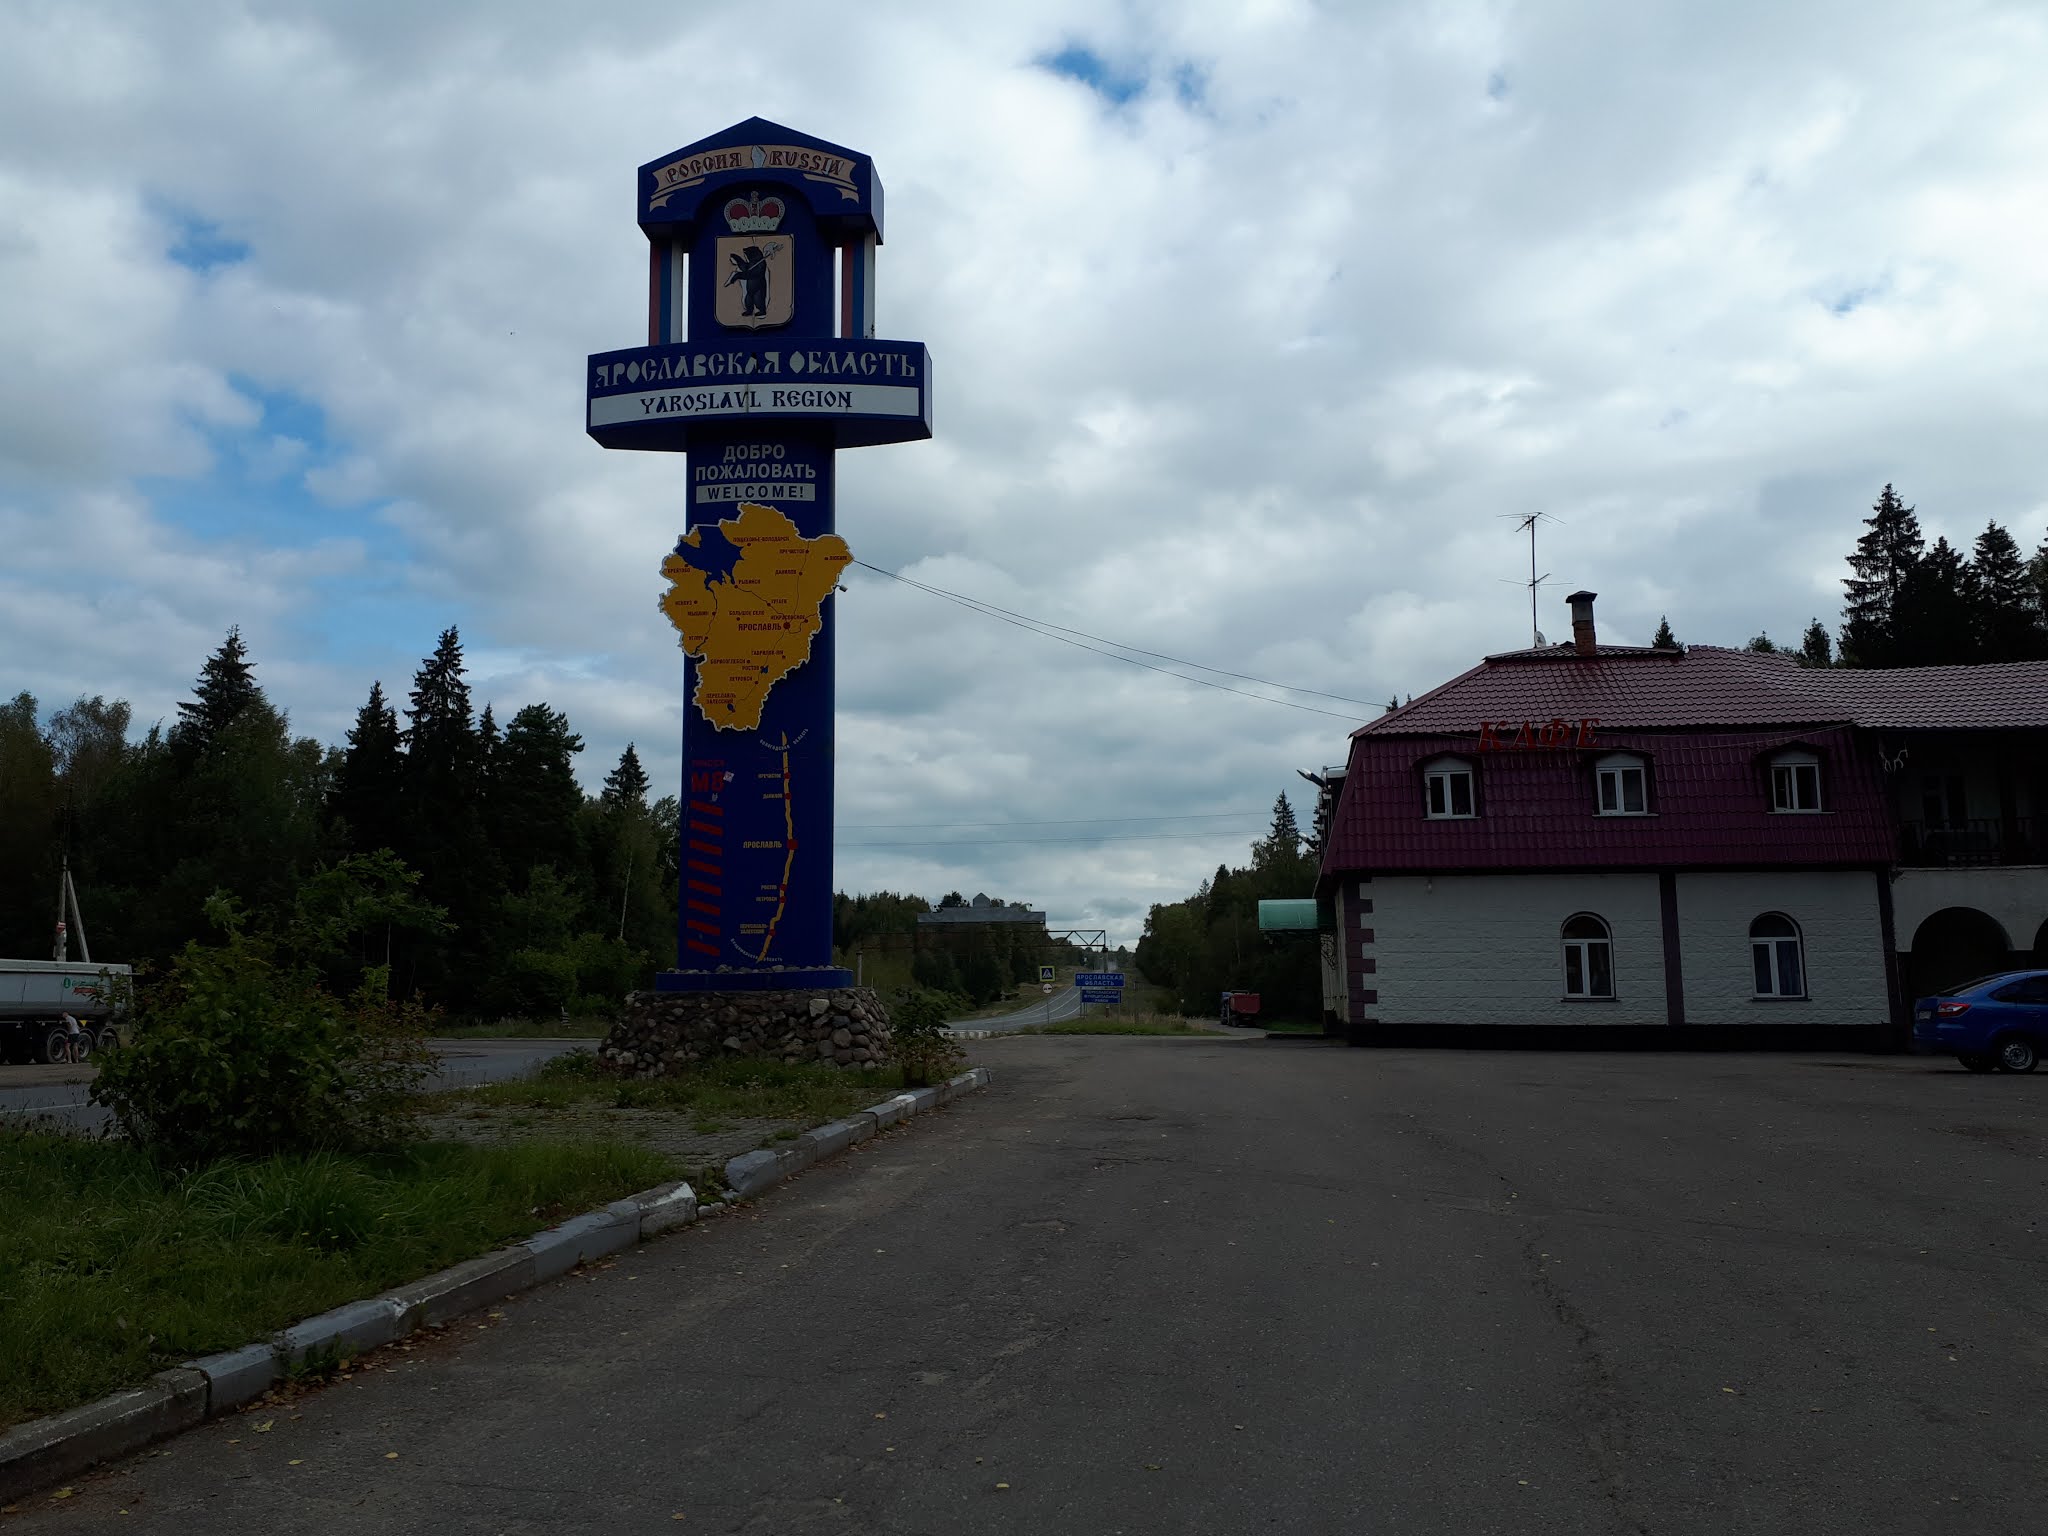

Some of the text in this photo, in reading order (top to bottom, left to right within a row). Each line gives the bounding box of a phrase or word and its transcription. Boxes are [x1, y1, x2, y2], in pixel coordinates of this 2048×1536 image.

[667, 153, 742, 183] РОССИЯ
[595, 350, 916, 389] ЯРОСЛАВСКАЯ ОБЛАСТЬ
[640, 390, 852, 414] YAROSLAVL REGION
[723, 444, 785, 463] ДОБРО
[696, 464, 816, 481] ПОЖАЛОВАТЬ
[708, 486, 804, 499] WELCOME!
[738, 623, 782, 631] ЯРОСЛАВЛЬ
[1479, 718, 1601, 752] КАФЕ
